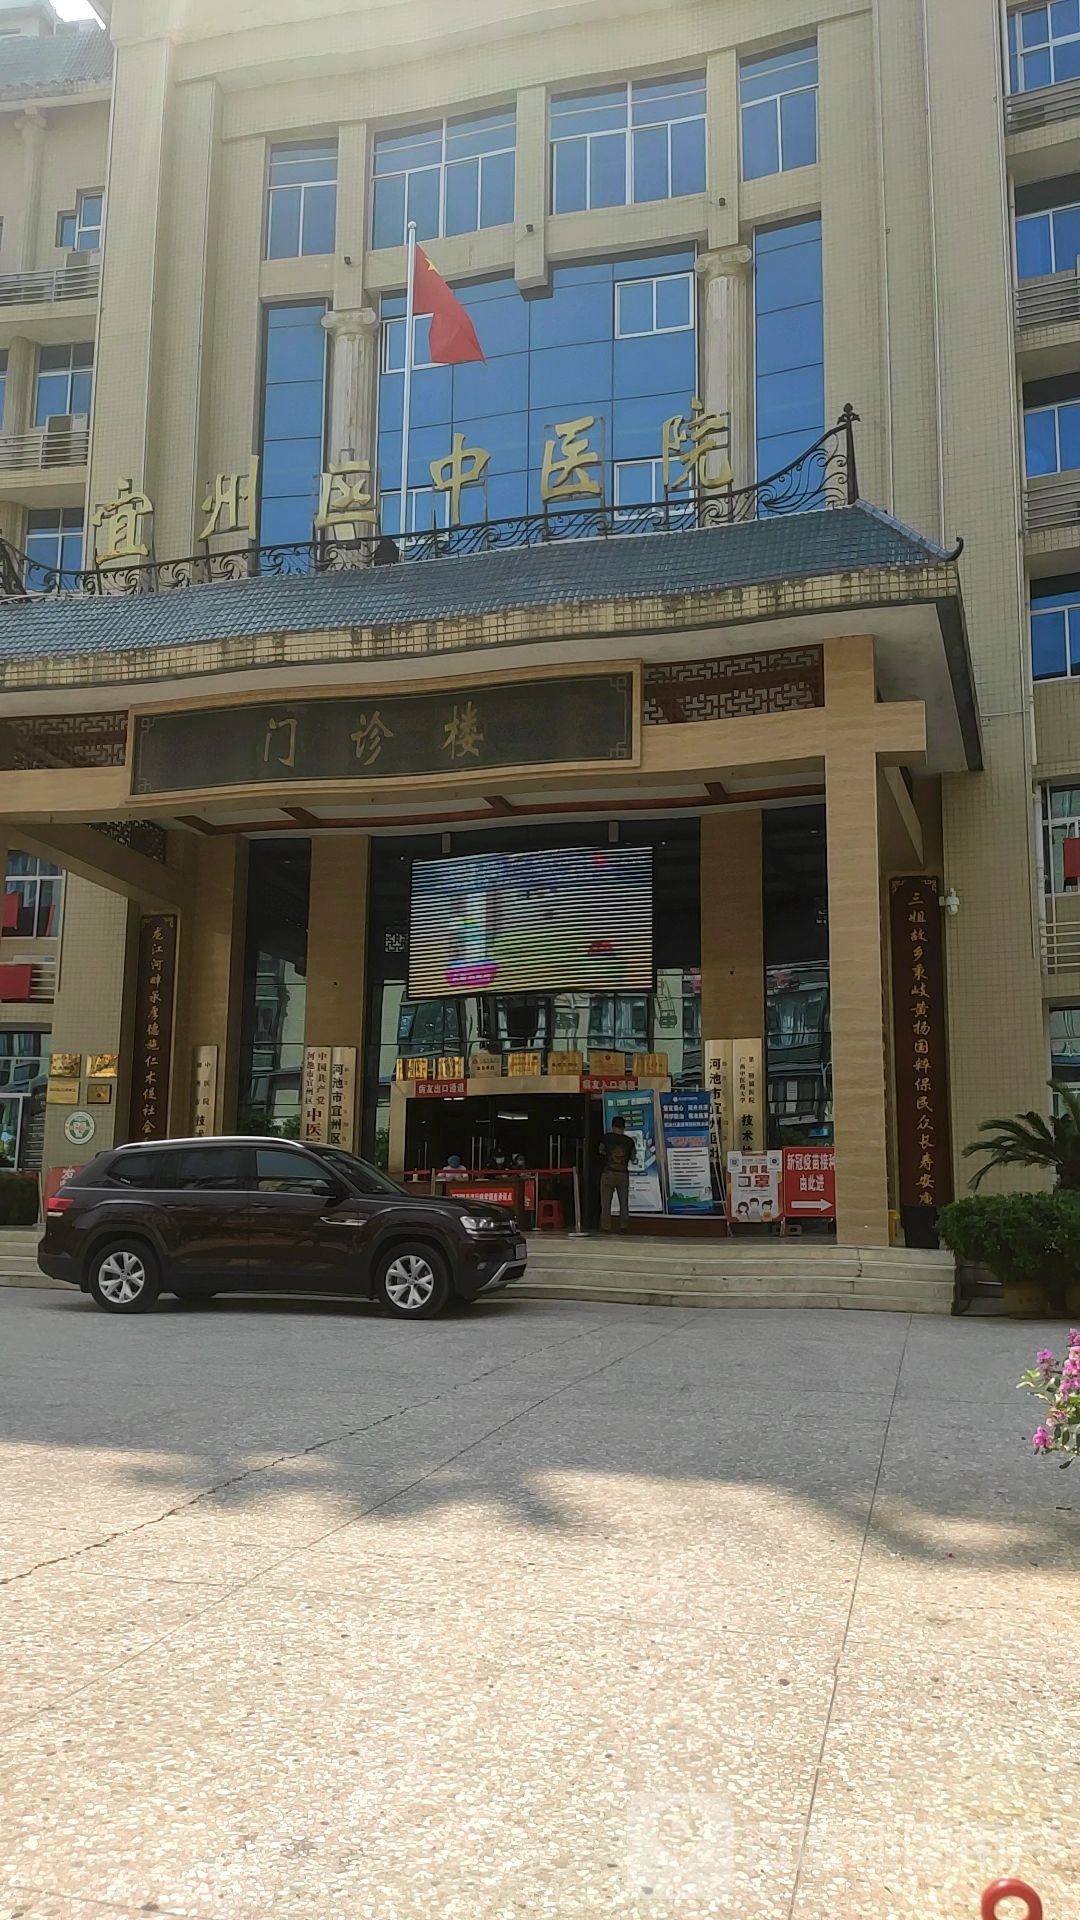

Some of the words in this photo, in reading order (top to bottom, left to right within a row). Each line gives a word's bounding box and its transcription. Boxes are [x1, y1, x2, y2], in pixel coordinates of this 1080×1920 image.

[92, 397, 734, 566] 宜州区中医院
[262, 699, 486, 770] 门诊楼
[141, 926, 165, 1139] 龙江河畔承厚德施仁术促社会
[316, 1051, 328, 1105] 中国共产党
[330, 1063, 344, 1145] 河池市宜州区
[305, 1107, 323, 1143] 中医
[738, 1174, 771, 1188] 口罩
[786, 1153, 836, 1171] 新冠疫苗接种
[799, 1173, 825, 1192] 由此进
